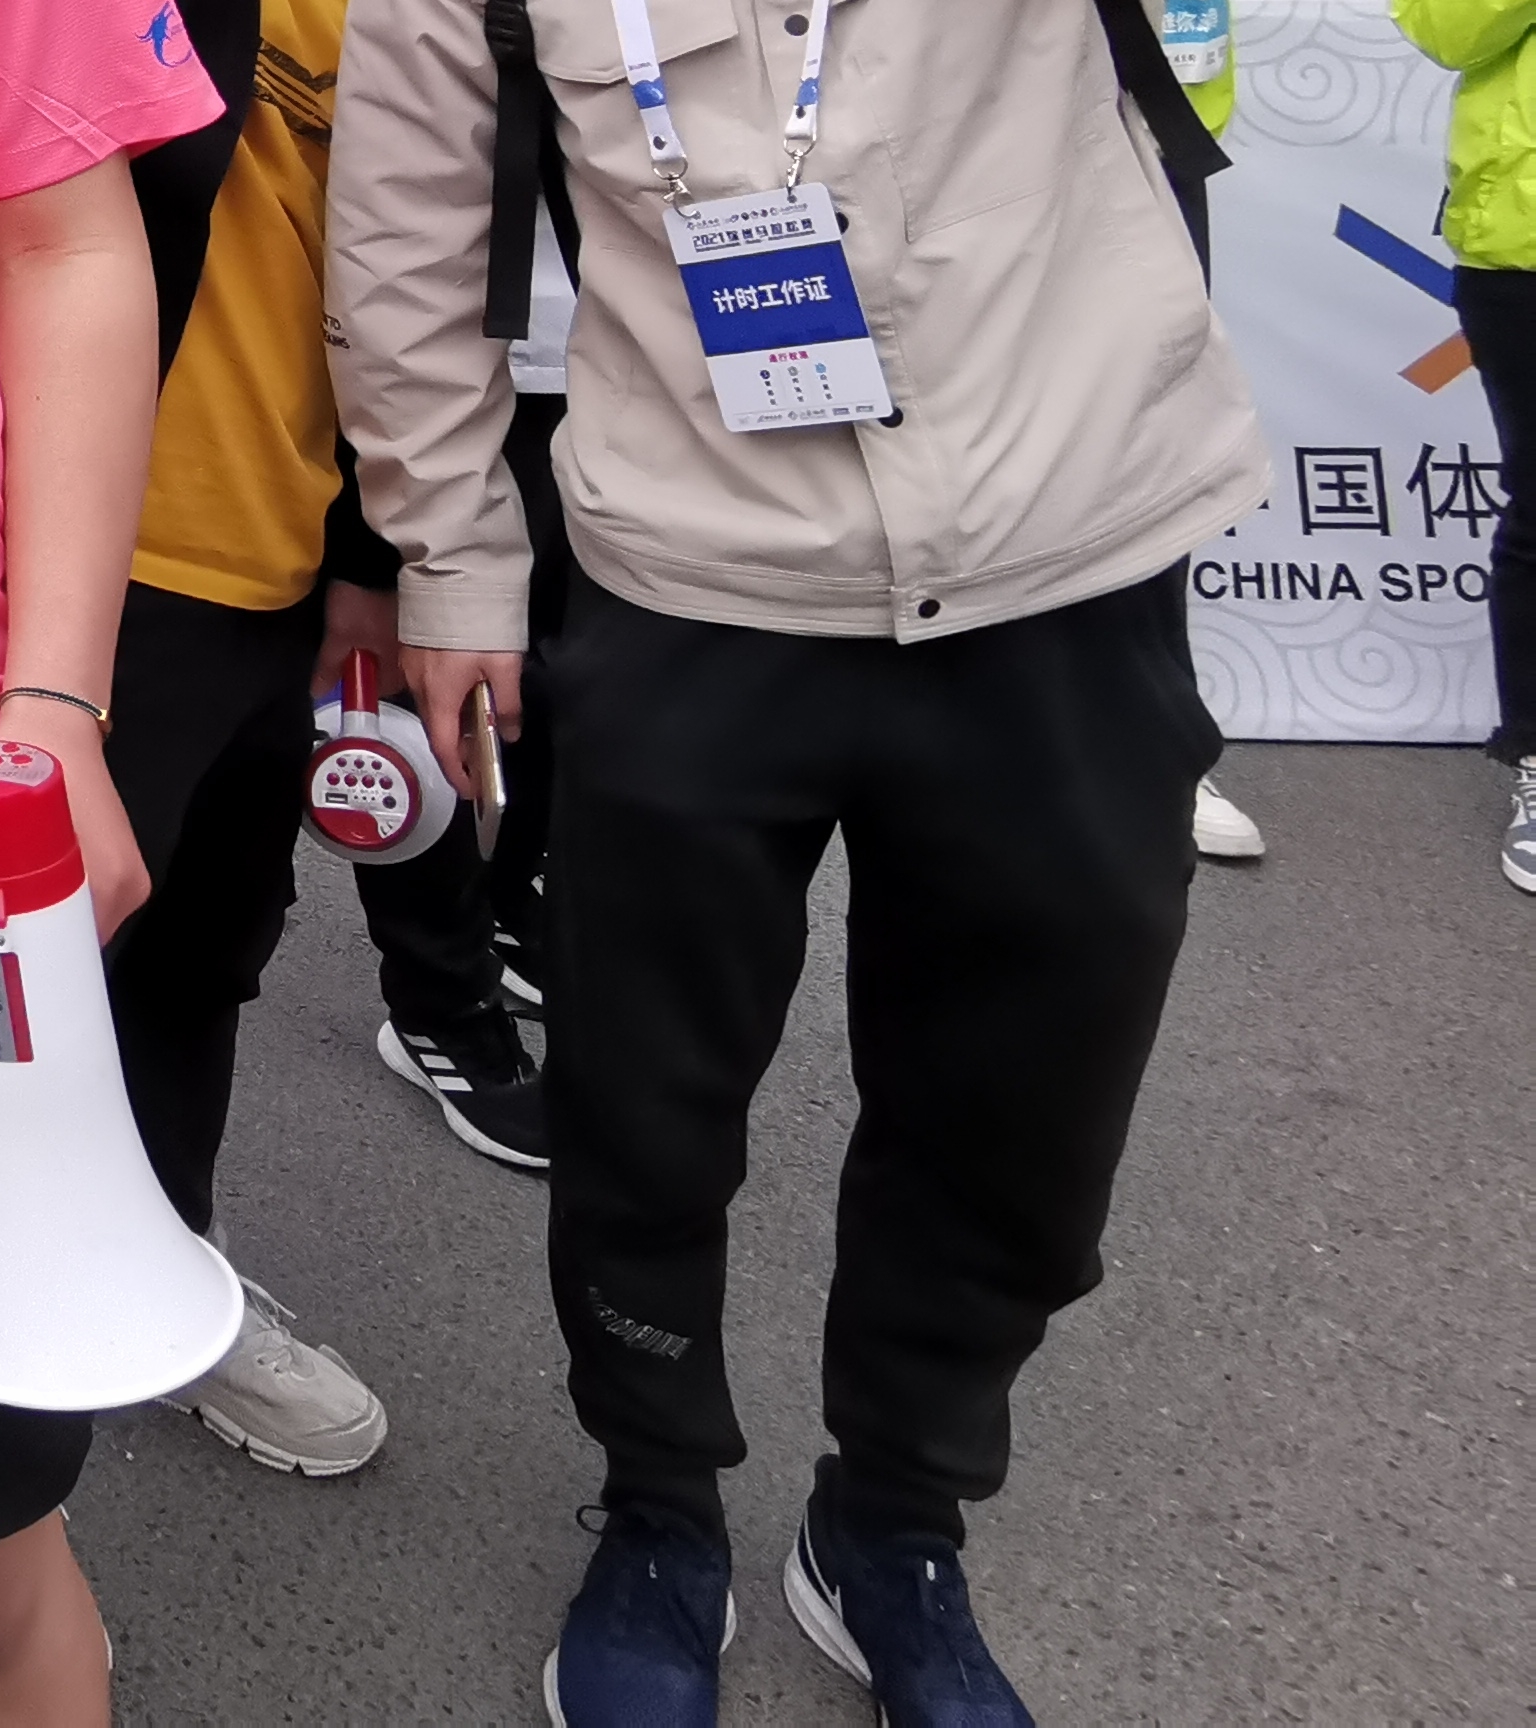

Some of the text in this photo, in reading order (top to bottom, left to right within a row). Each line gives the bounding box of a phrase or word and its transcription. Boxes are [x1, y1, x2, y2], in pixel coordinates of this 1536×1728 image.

[712, 275, 832, 314] 计时工作证
[1224, 442, 1512, 539] 国体
[1192, 560, 1490, 603] CHINA SPO
